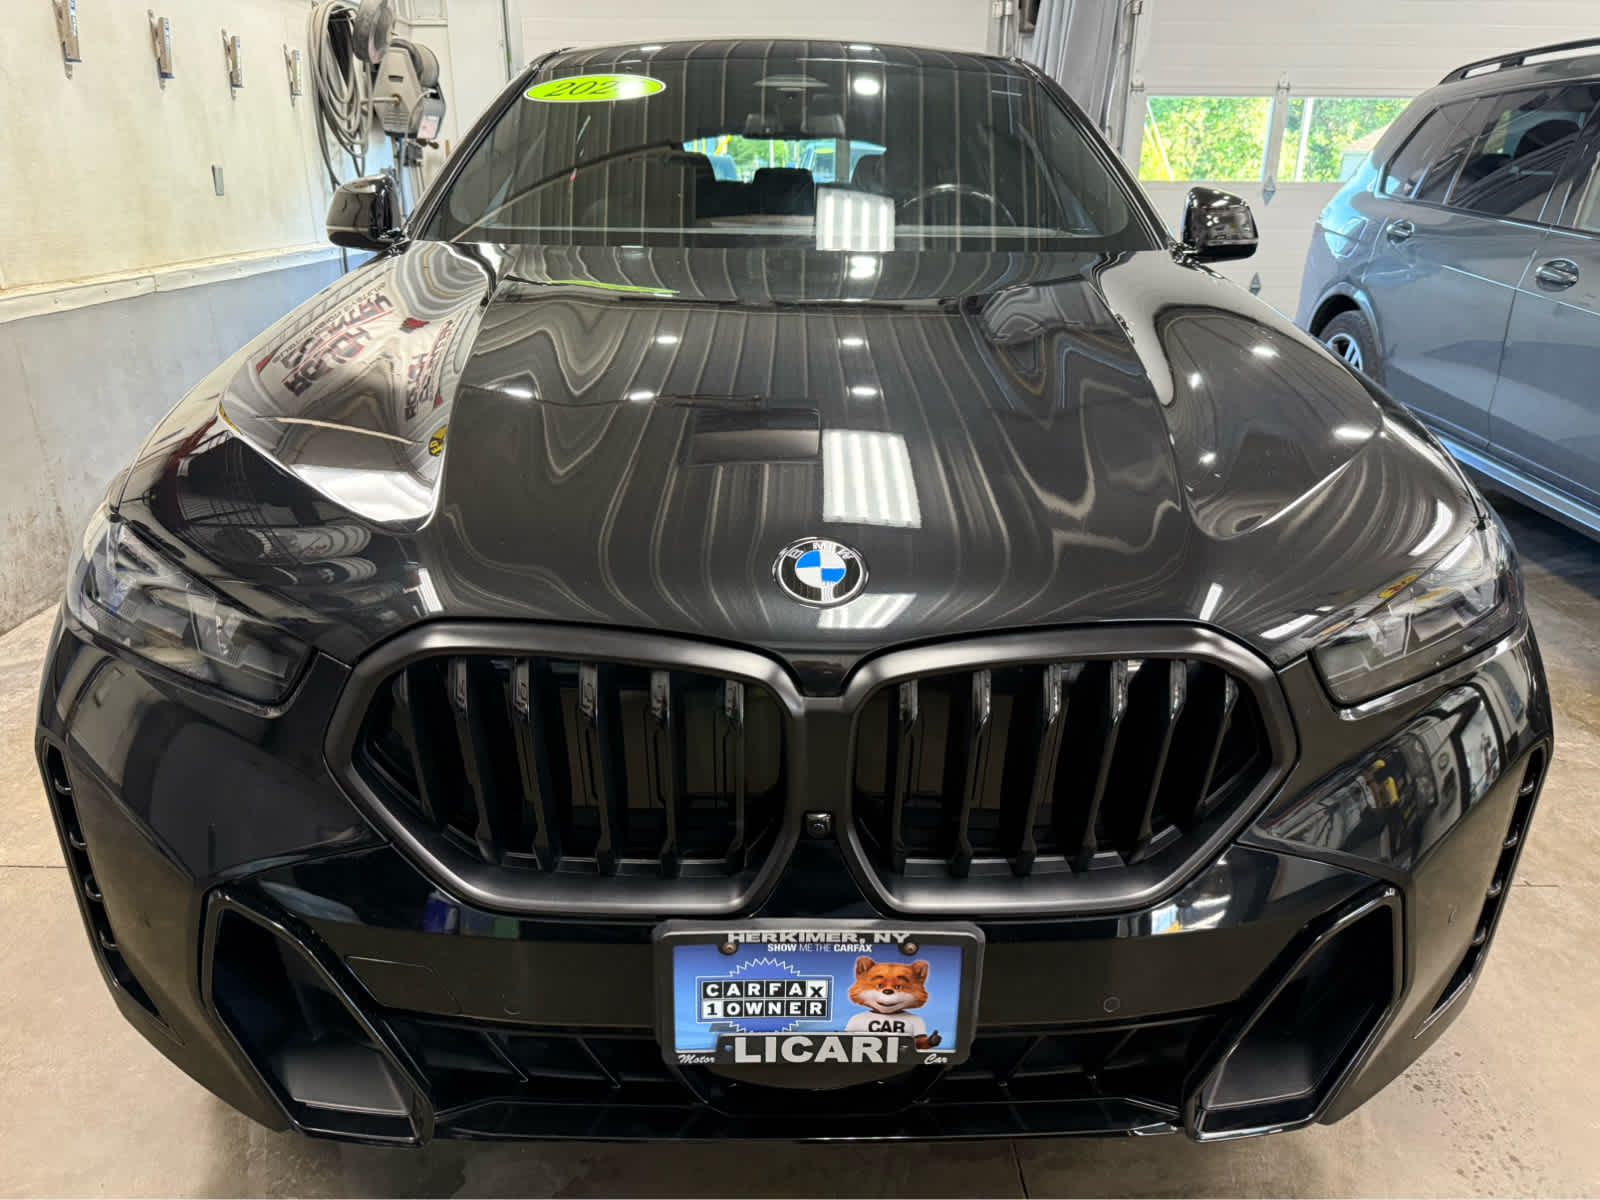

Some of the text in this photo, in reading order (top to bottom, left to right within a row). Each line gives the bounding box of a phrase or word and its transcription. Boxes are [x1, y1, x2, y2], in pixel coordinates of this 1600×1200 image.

[544, 80, 645, 98] 202
[786, 541, 856, 560] BMW
[727, 931, 911, 945] HERKIMER, NY
[767, 943, 872, 953] SHOW ME THE CARFAX
[705, 982, 824, 998] CARFAX
[868, 1020, 906, 1033] CAR
[734, 1035, 899, 1064] LICARI
[677, 1053, 715, 1065] Motor
[923, 1052, 948, 1065] Car
